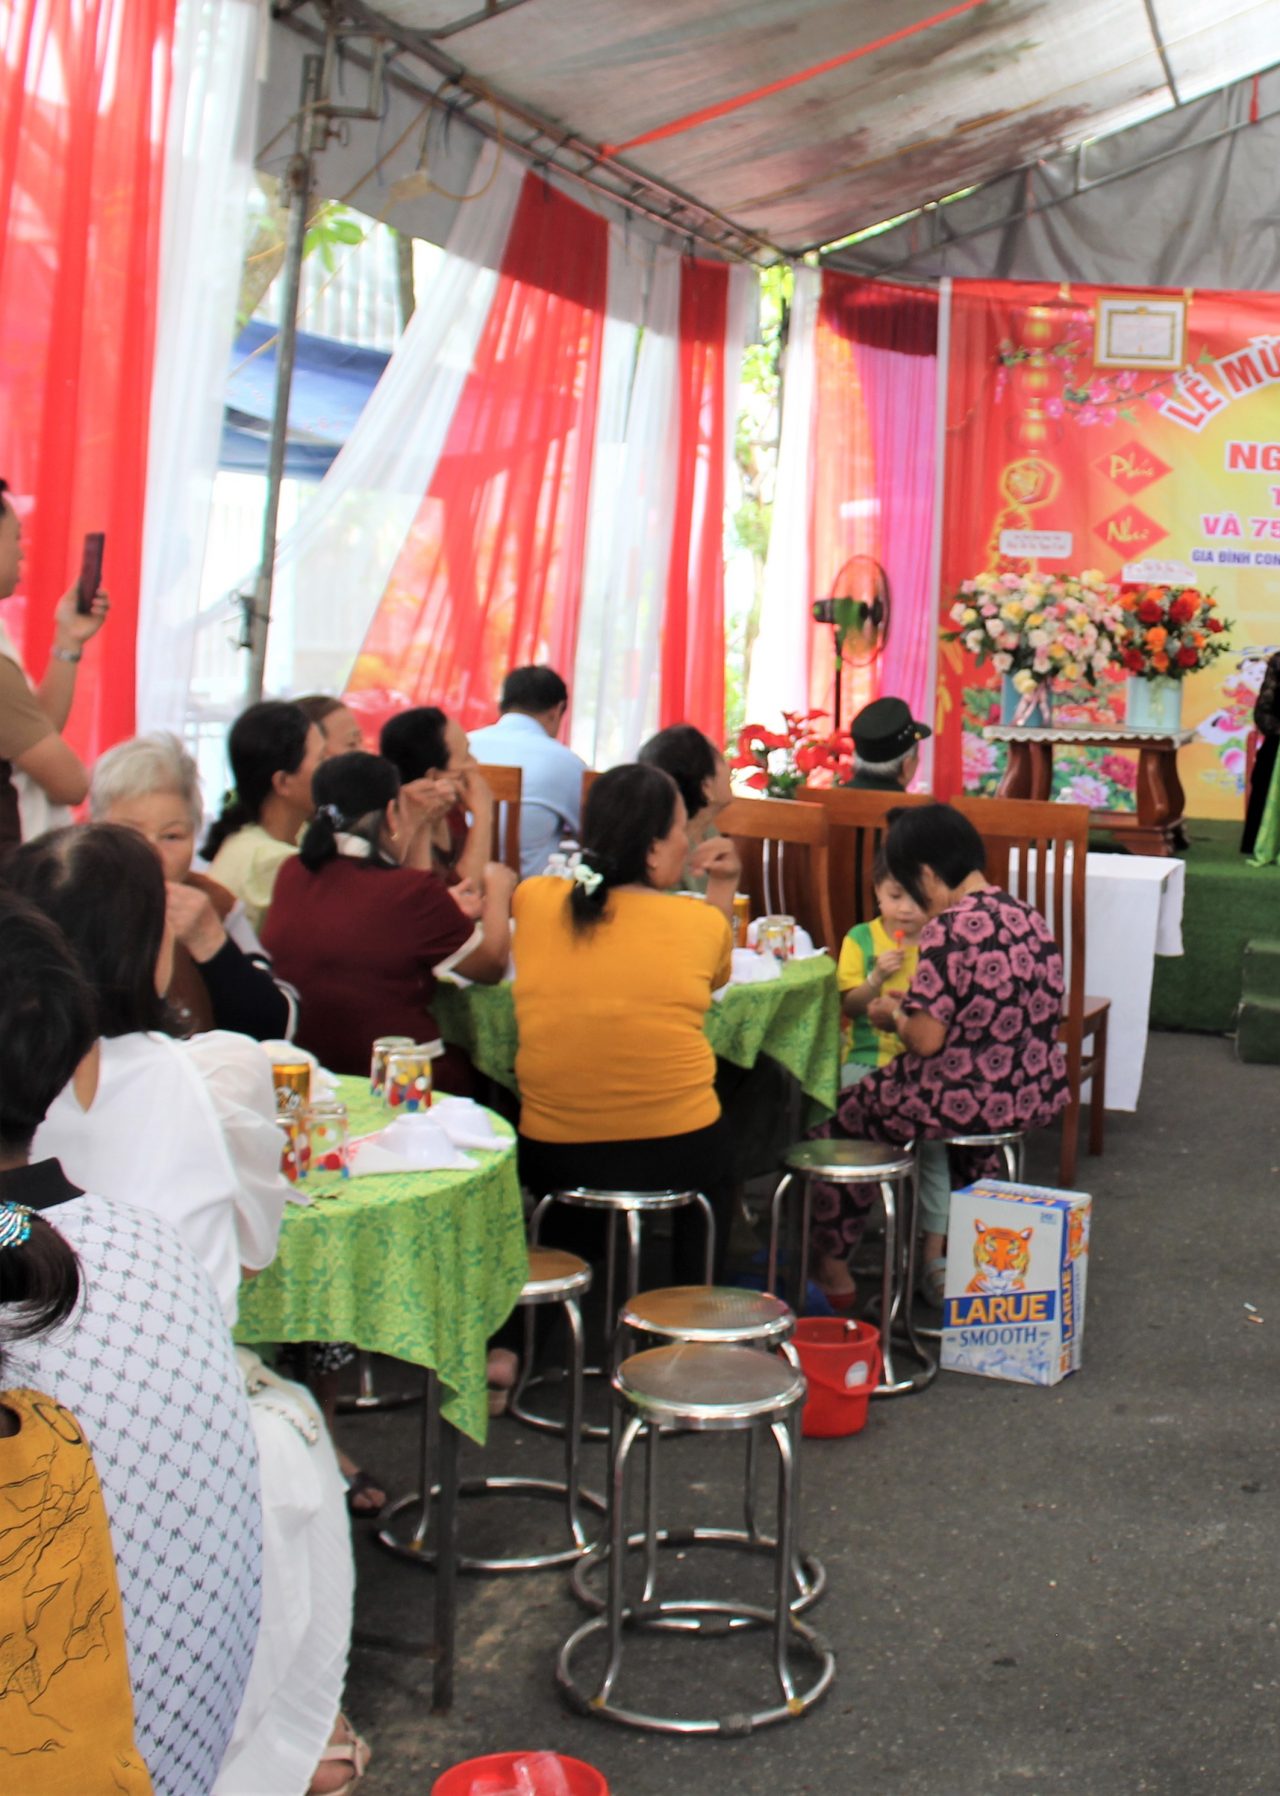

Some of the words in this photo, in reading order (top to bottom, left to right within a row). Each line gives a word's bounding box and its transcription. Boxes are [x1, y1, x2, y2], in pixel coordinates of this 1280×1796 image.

[1167, 370, 1224, 427] LỄ
[1203, 513, 1241, 537] VÀ
[1191, 548, 1214, 562] GIA
[1218, 547, 1251, 564] ĐÌNH
[949, 1293, 1049, 1327] LARUE
[959, 1327, 1038, 1348] SMOOTH
